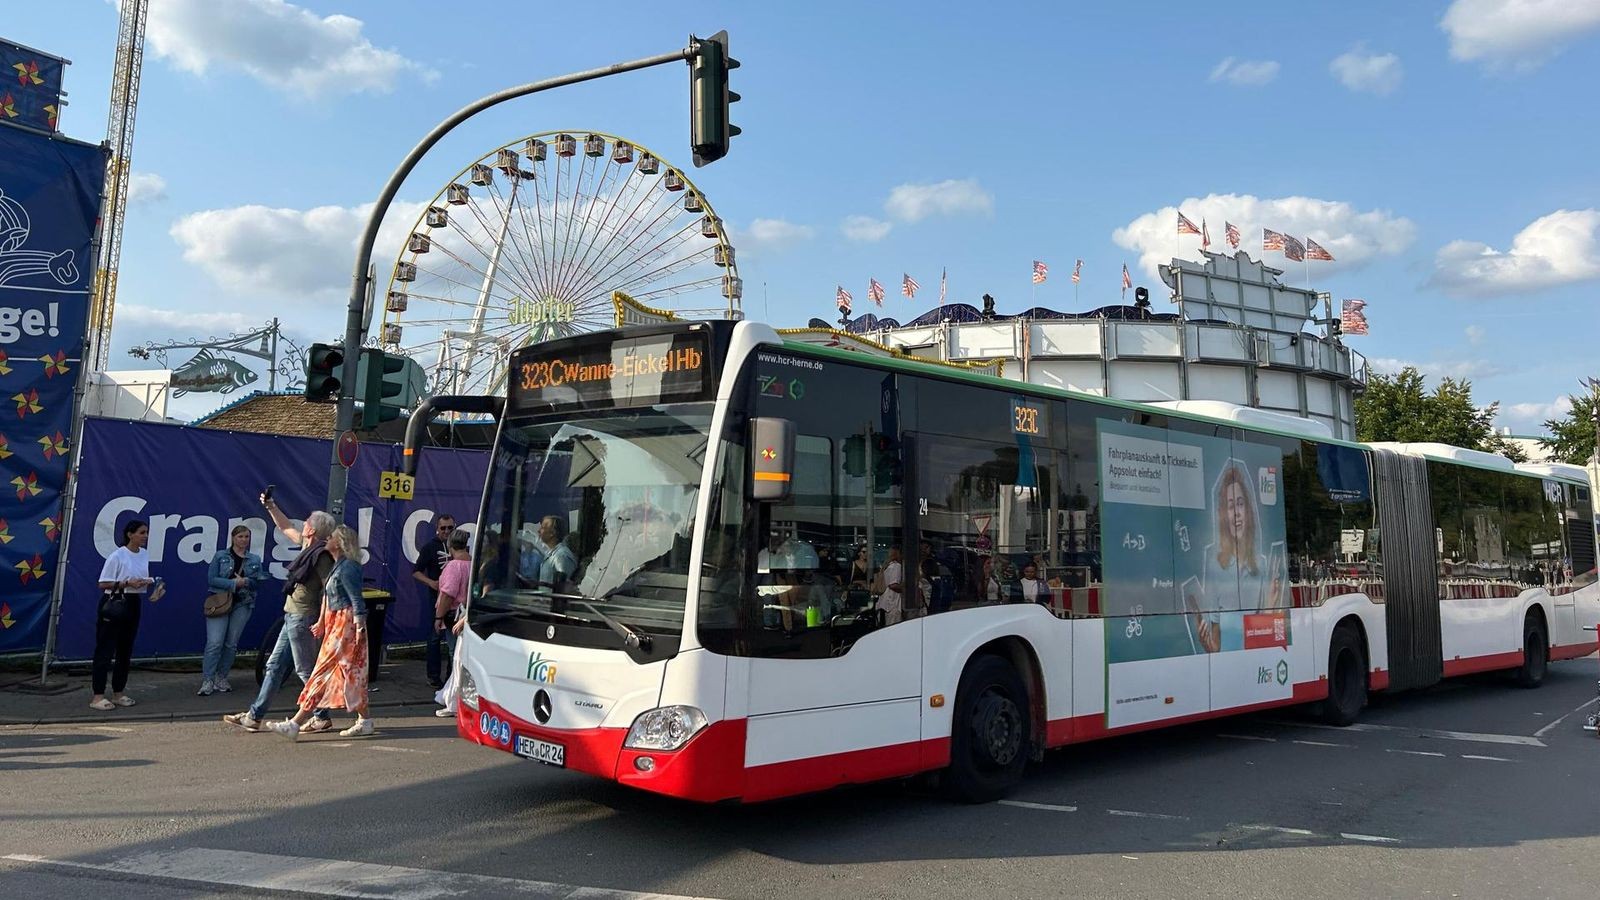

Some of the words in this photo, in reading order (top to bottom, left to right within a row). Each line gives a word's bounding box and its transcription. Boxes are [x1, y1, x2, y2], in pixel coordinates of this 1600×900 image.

[507, 294, 576, 328] Jupiter
[521, 359, 563, 390] 323C
[564, 350, 674, 383] Wanne-Eickel
[757, 353, 824, 370] www.hcr-herne.de
[1014, 406, 1039, 434] 323C
[383, 477, 411, 494] 316
[1545, 481, 1563, 503] HCR
[919, 498, 928, 516] 24
[526, 651, 558, 684] HCR
[519, 737, 536, 757] HER
[551, 746, 564, 763] 24
